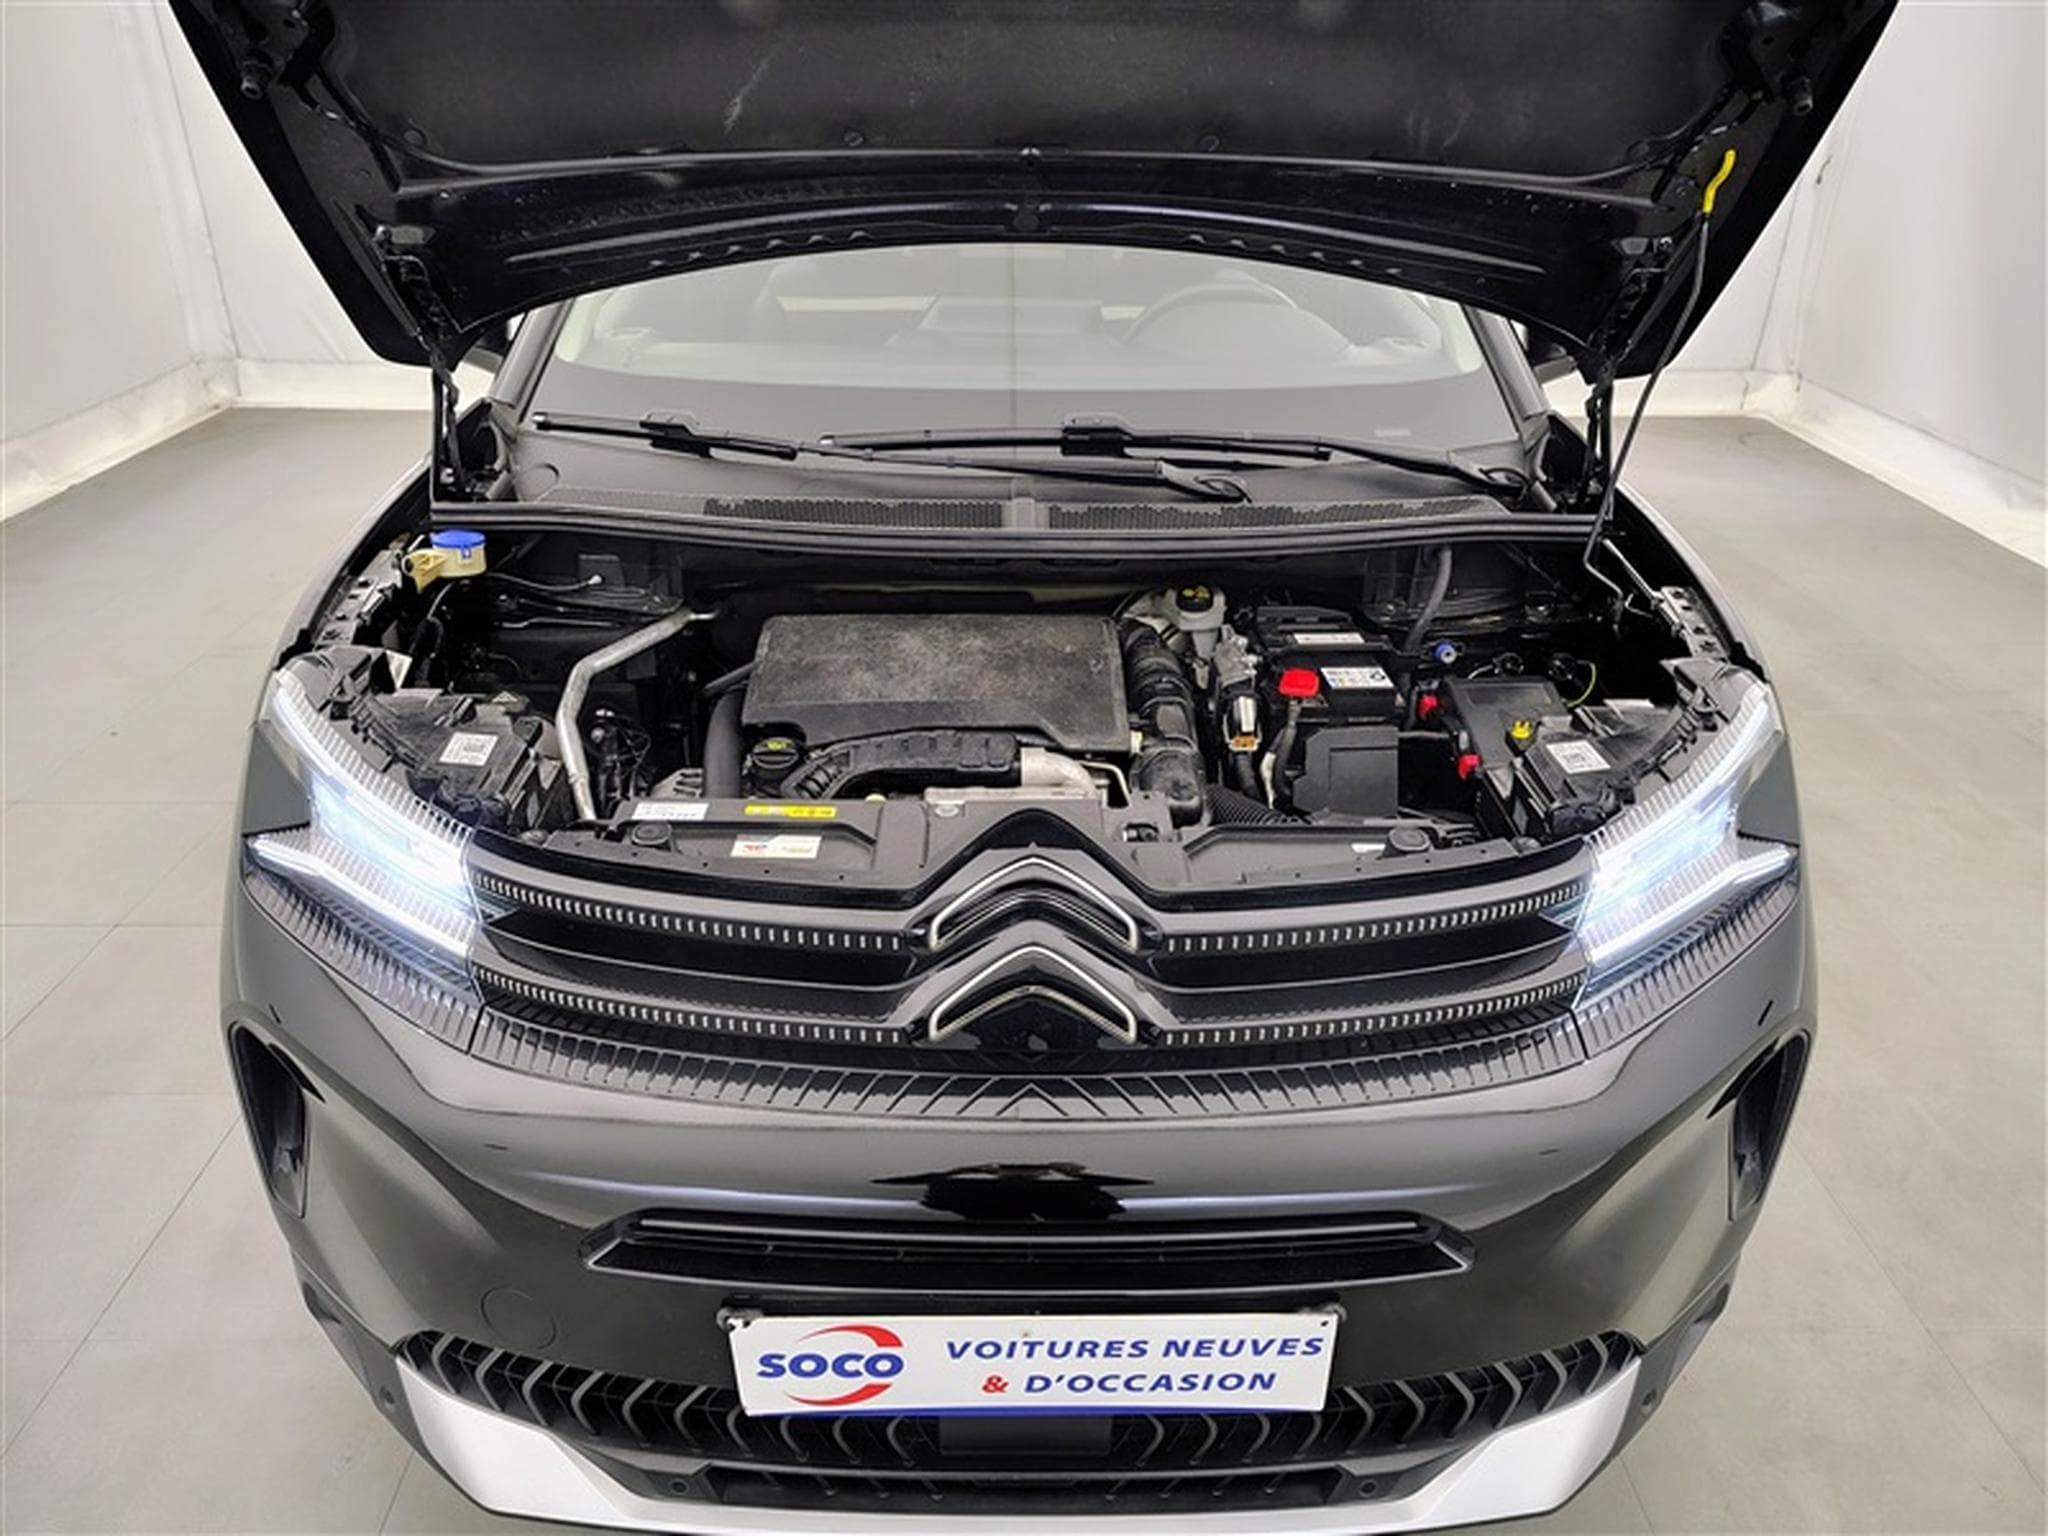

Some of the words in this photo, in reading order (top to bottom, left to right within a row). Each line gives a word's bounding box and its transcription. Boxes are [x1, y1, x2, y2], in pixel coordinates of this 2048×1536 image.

[946, 1339, 1148, 1360] VOITURES
[1162, 1337, 1323, 1358] NEUVES
[757, 1351, 904, 1379] SOCO
[981, 1374, 1008, 1394] &
[1025, 1372, 1277, 1394] D'OCCASION
